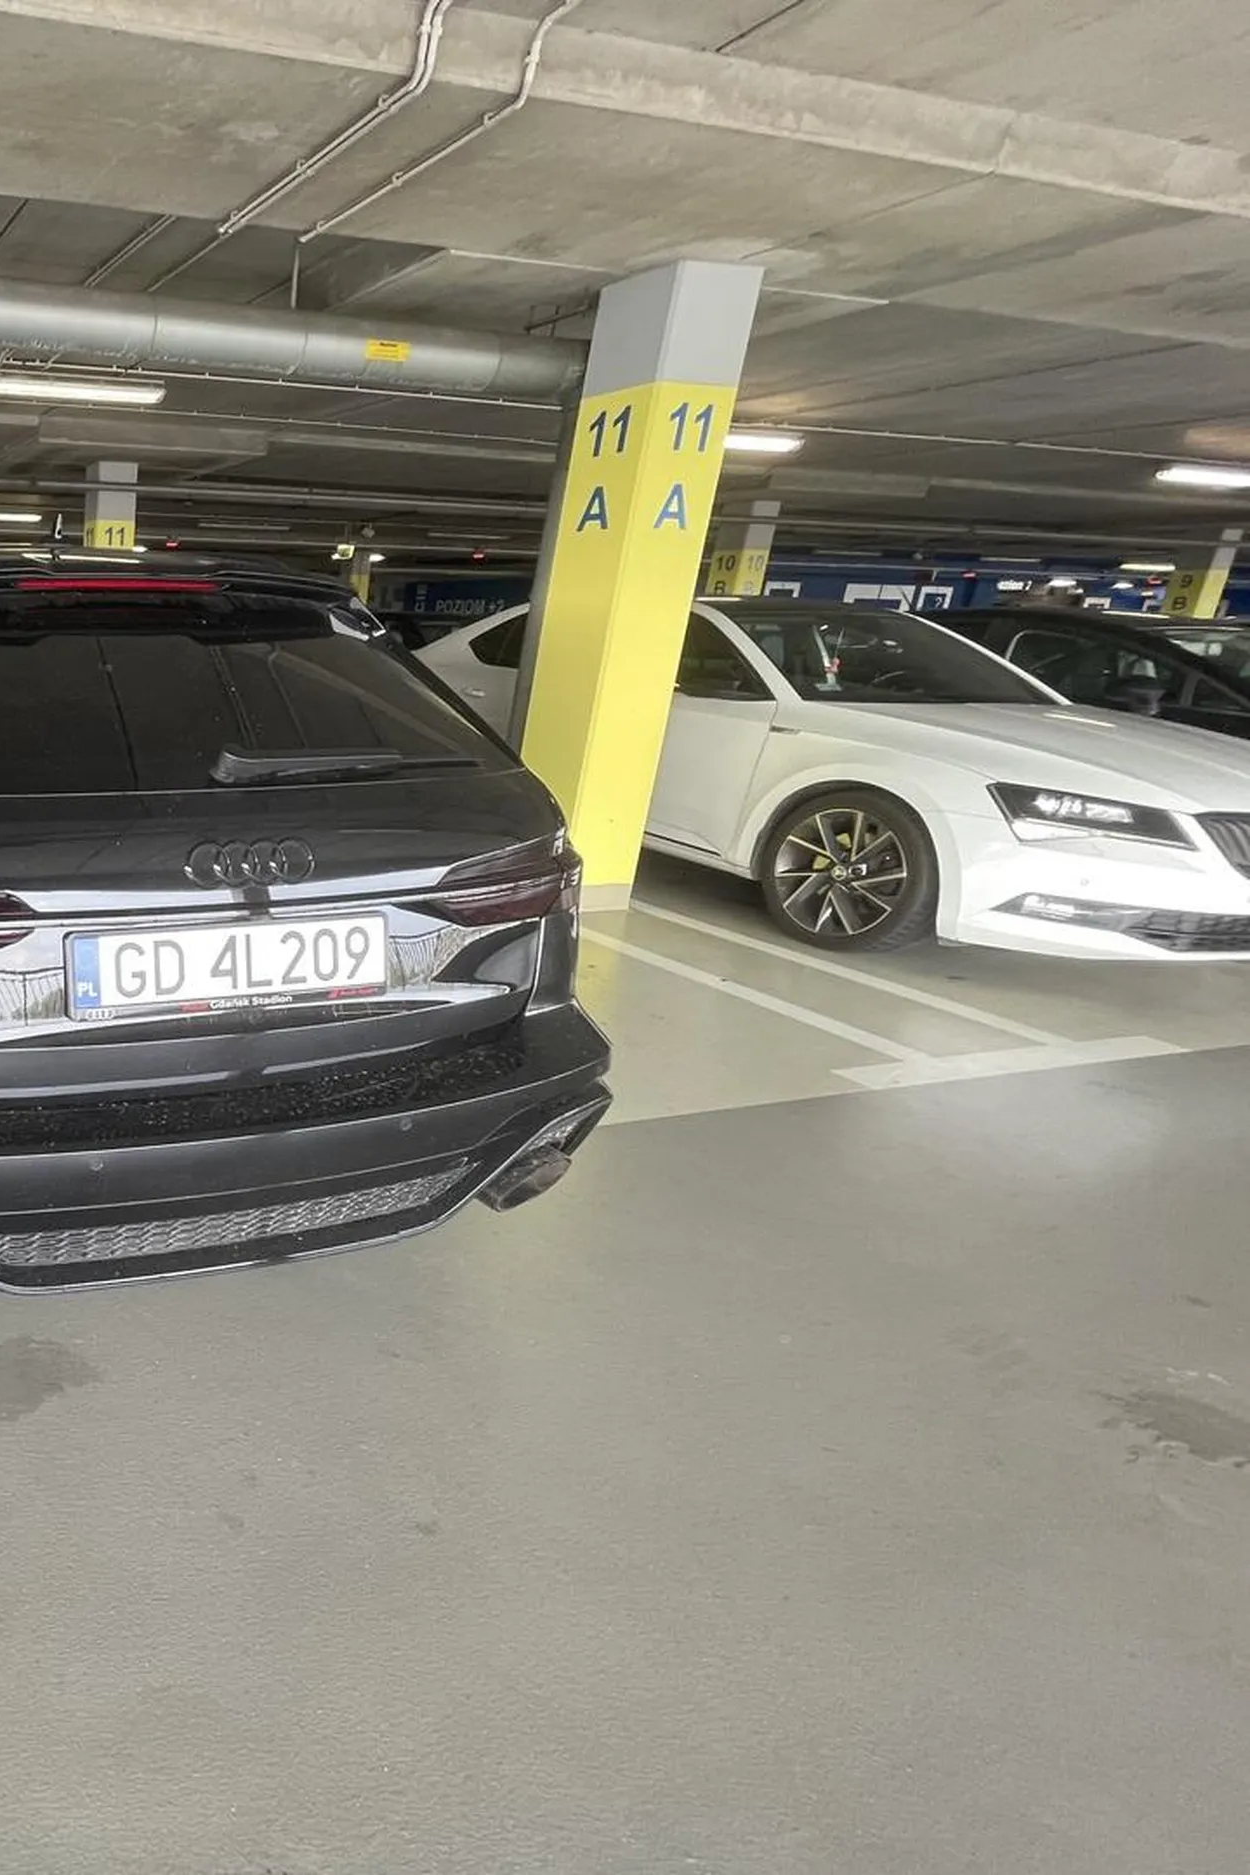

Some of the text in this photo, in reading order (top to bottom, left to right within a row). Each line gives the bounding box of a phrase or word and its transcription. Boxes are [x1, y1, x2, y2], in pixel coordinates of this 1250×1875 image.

[588, 405, 632, 458] 11
[669, 402, 714, 453] 11
[575, 485, 609, 532] A
[653, 482, 687, 530] A
[104, 526, 125, 546] 11
[716, 555, 737, 572] 10
[747, 555, 765, 572] 10
[1180, 574, 1193, 588] 9
[434, 599, 485, 616] POZIOM
[1171, 596, 1186, 611] B
[114, 926, 371, 999] GD 4L209
[76, 981, 98, 998] PL
[251, 993, 293, 1008] Stadion
